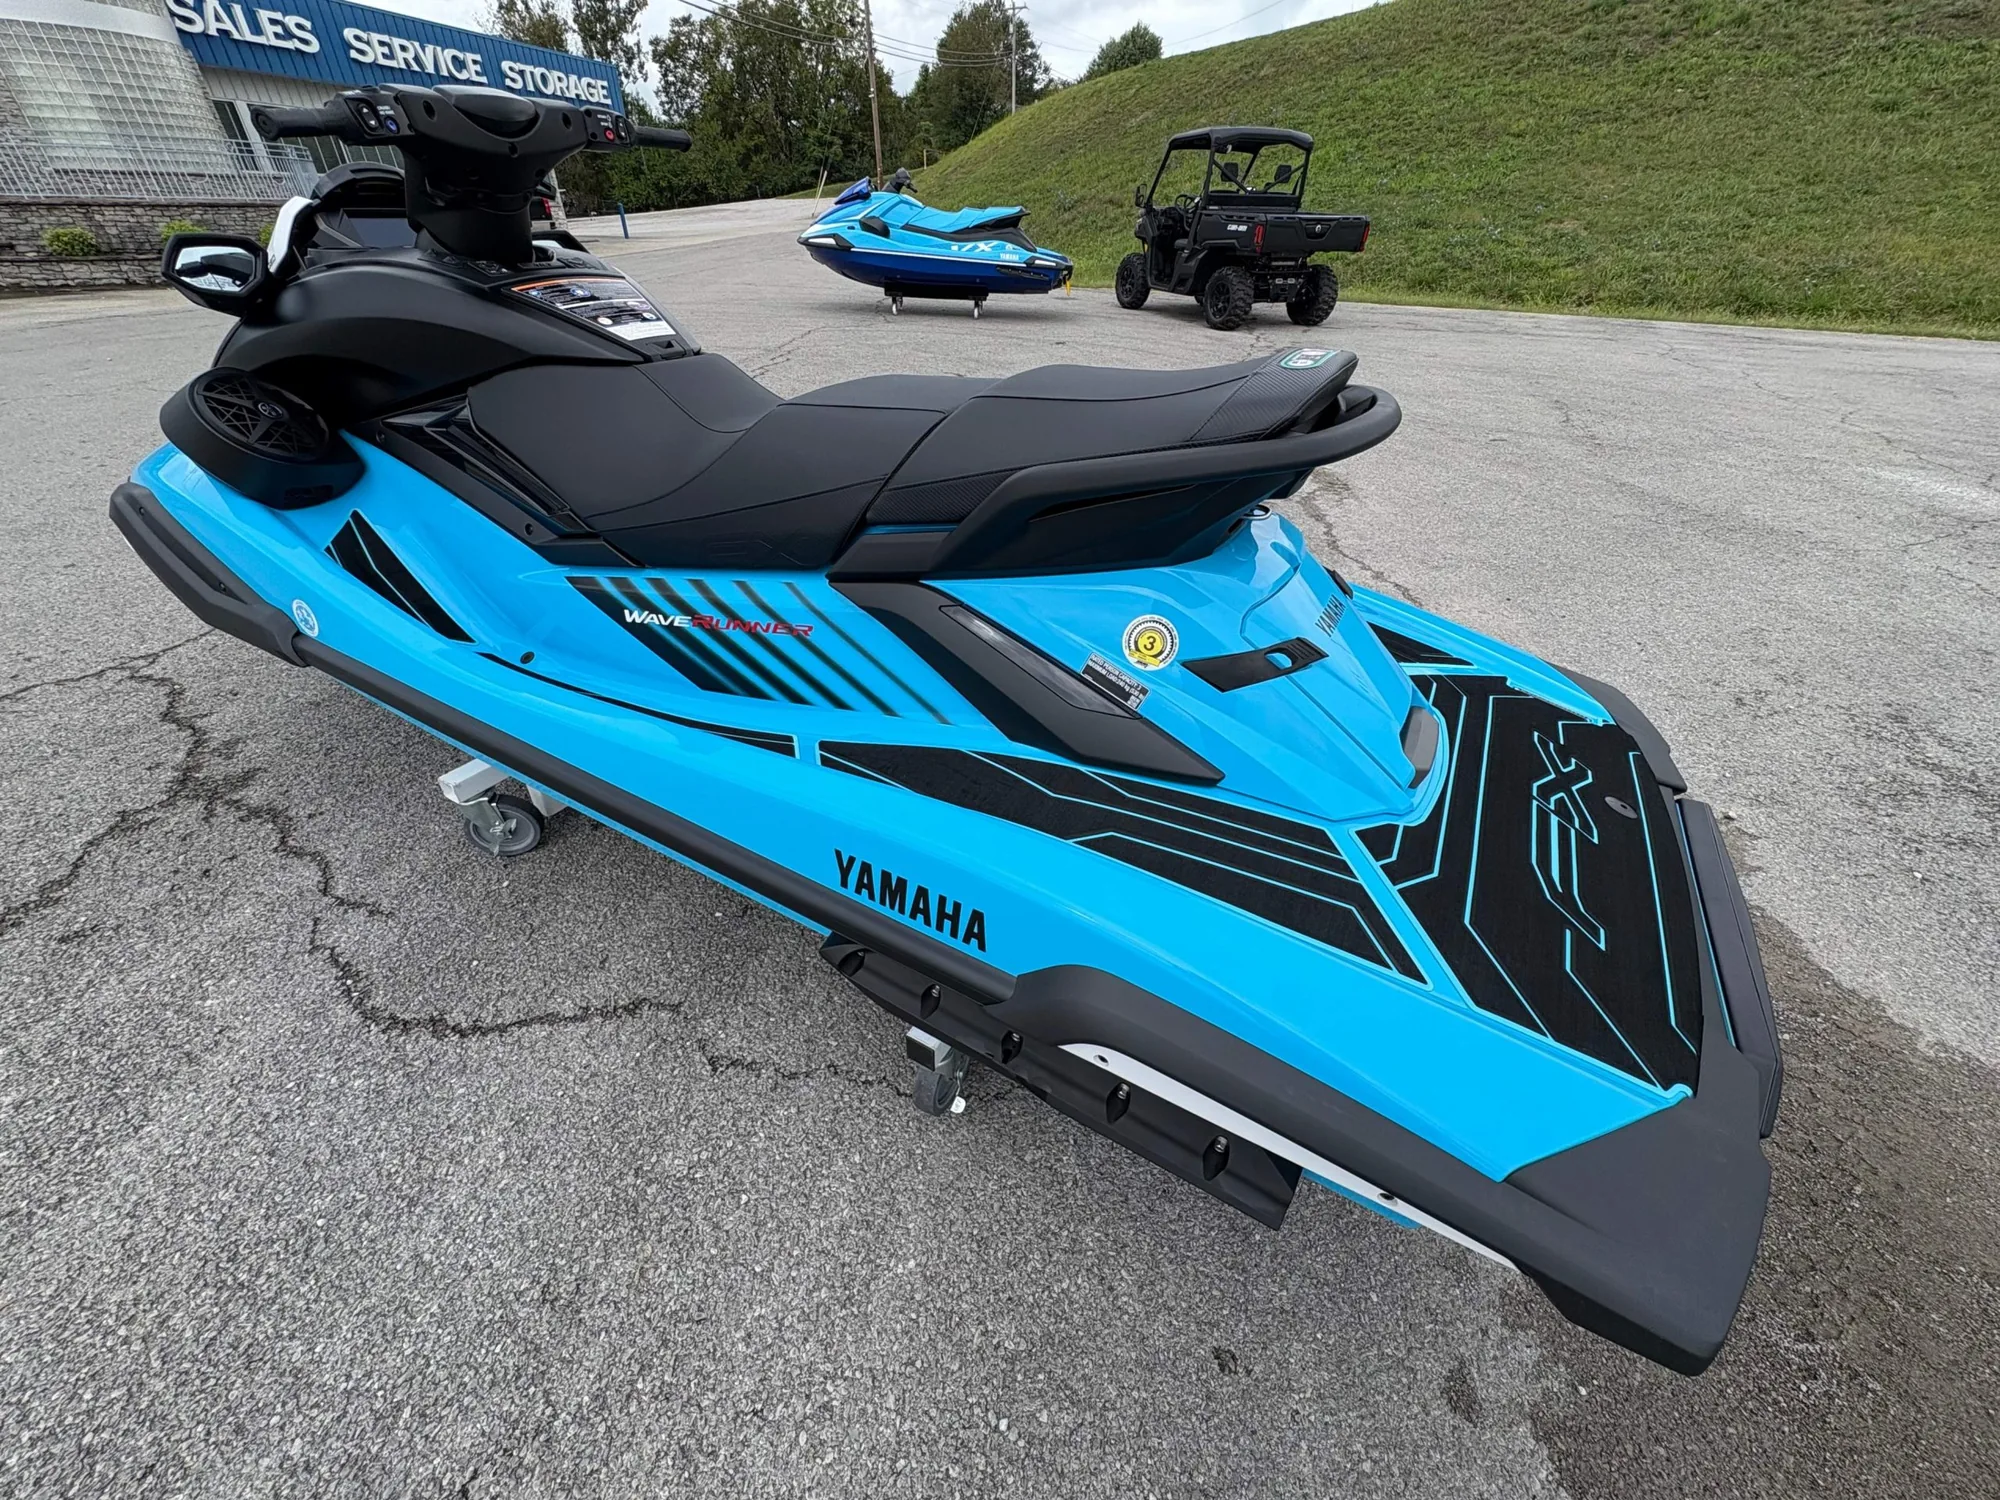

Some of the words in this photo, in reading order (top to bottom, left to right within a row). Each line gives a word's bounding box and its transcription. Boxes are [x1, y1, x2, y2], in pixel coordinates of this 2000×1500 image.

[166, 0, 320, 53] SALES
[343, 27, 488, 85] SERVICE
[501, 60, 612, 105] STORAGE
[1143, 635, 1156, 651] 3
[1314, 594, 1347, 638] YAMAHA
[834, 848, 986, 953] YAMAHA
